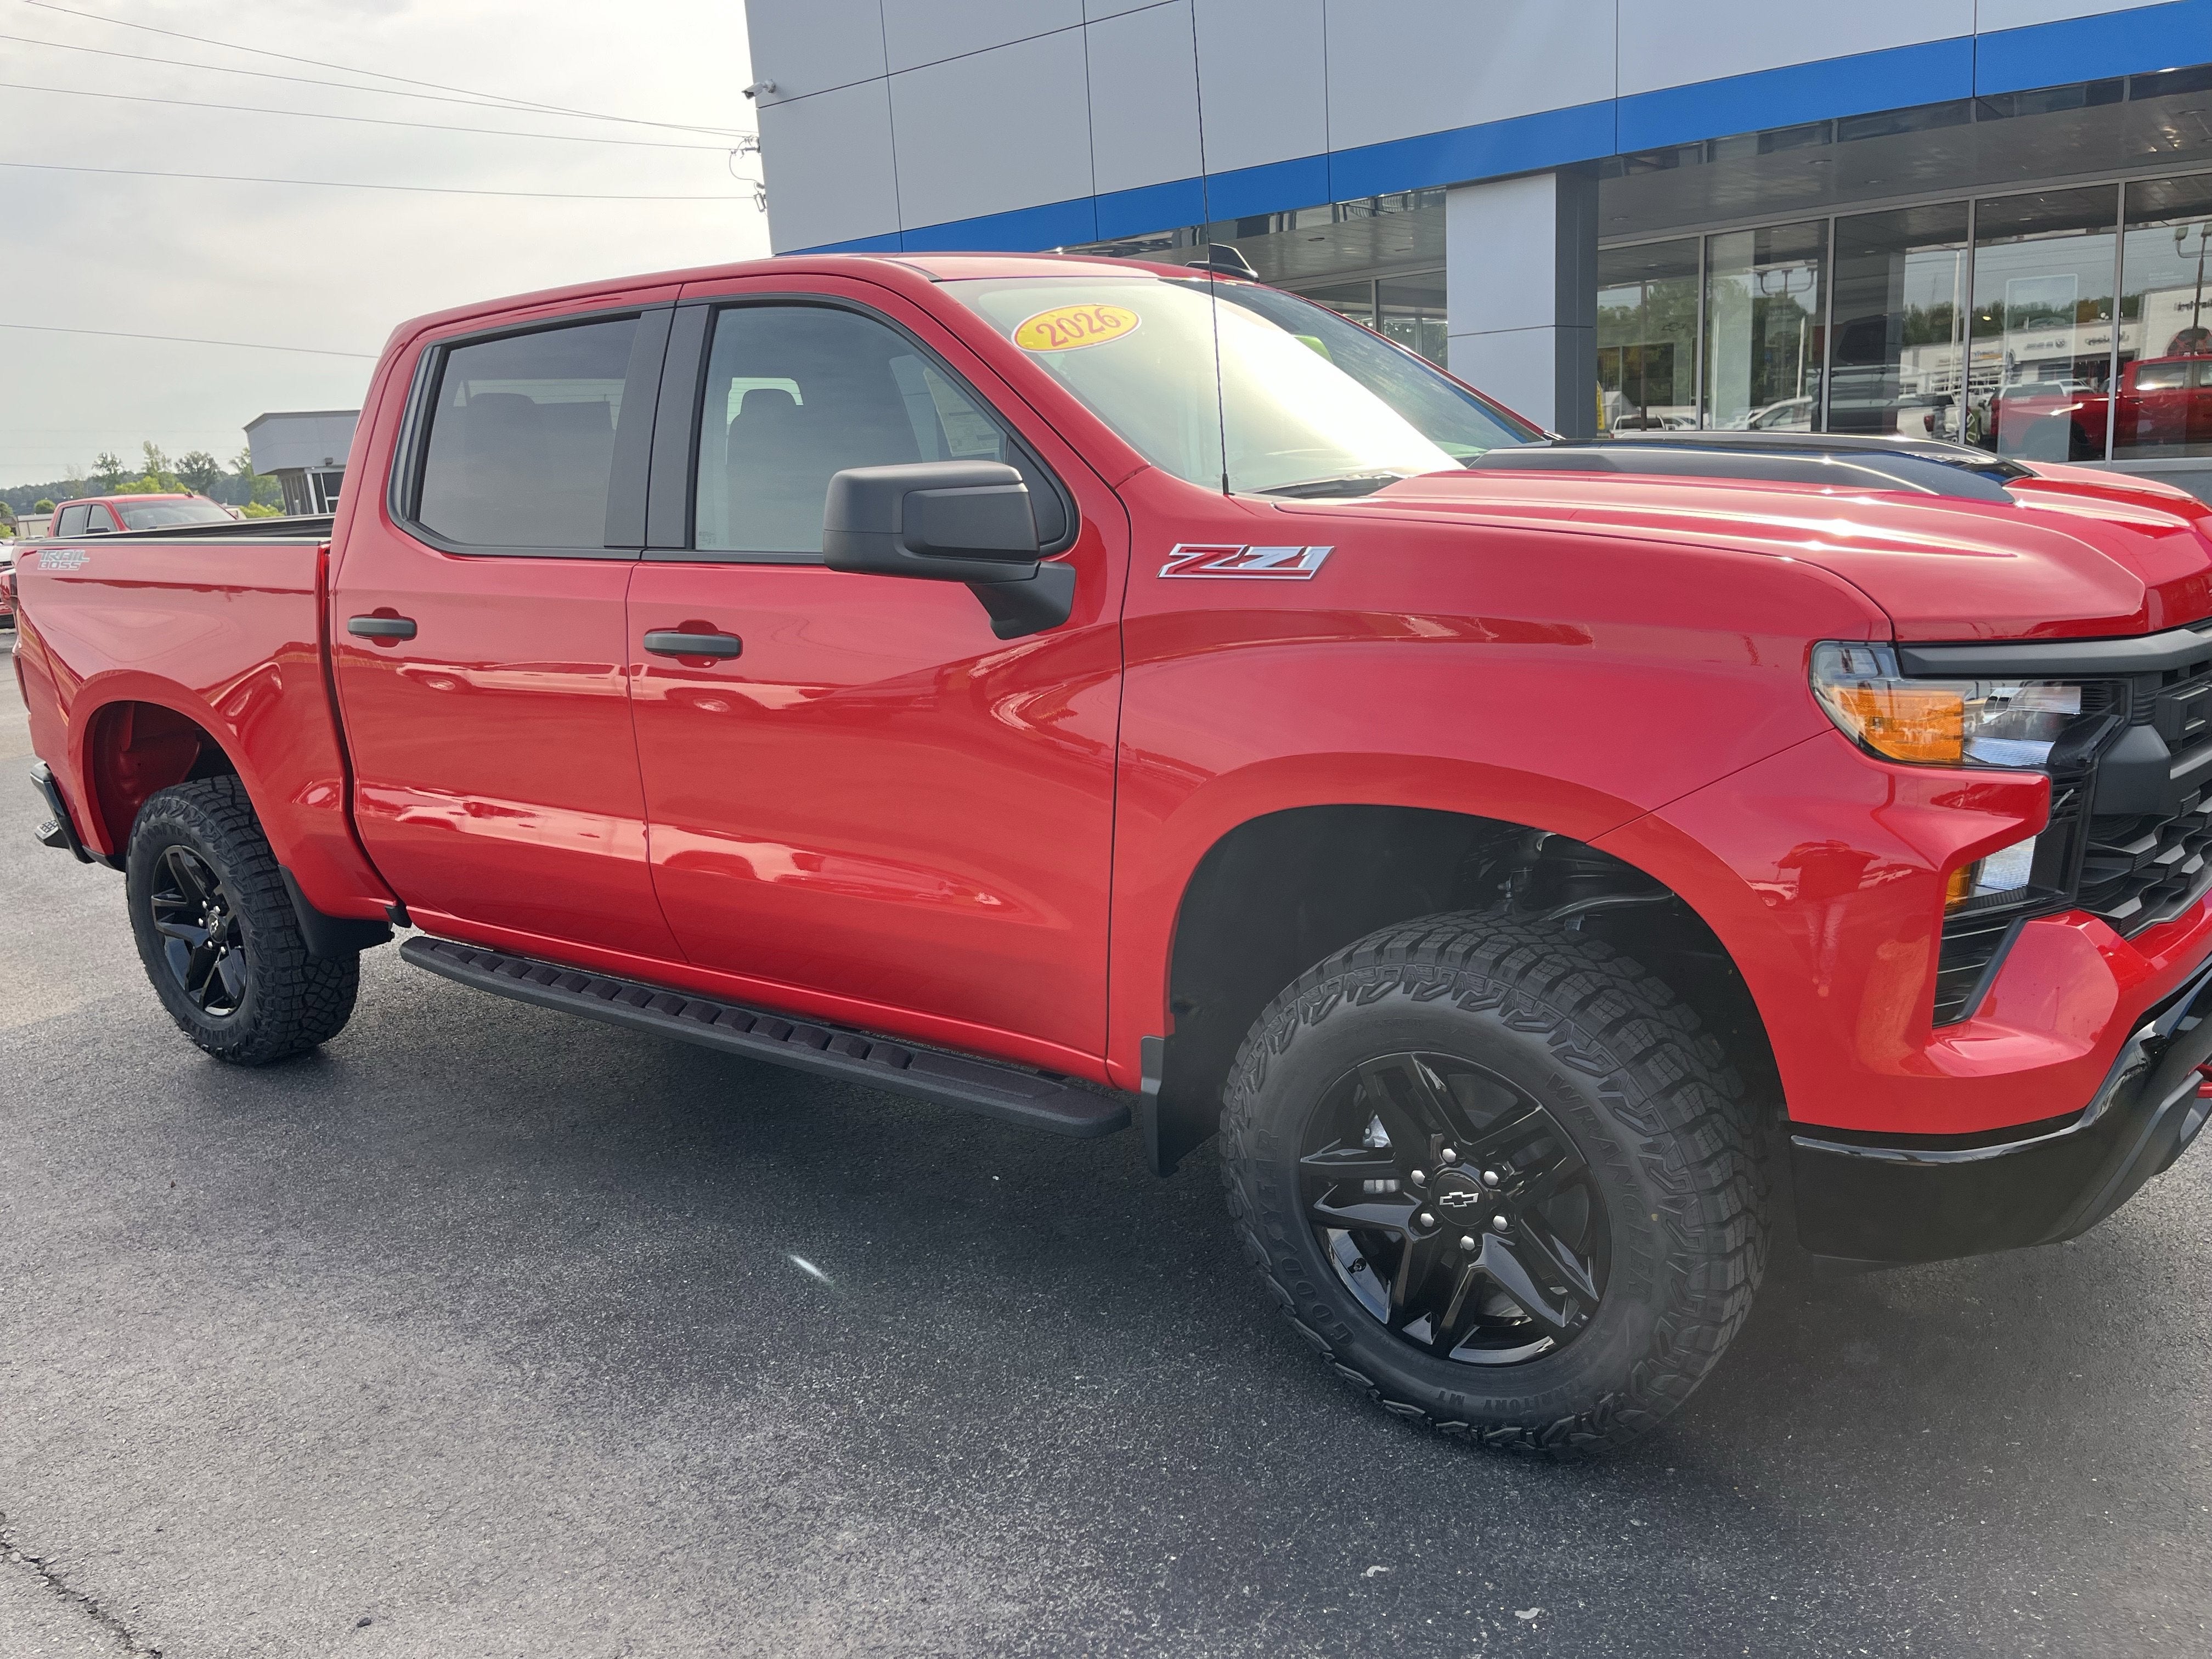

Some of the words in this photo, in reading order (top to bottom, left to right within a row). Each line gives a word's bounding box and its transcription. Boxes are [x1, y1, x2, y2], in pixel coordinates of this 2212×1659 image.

[1035, 307, 1121, 347] 2026
[37, 550, 89, 562] TRAIL
[38, 561, 81, 571] BOSS
[1156, 543, 1335, 580] Z71
[1545, 1071, 1654, 1301] WRANGLER
